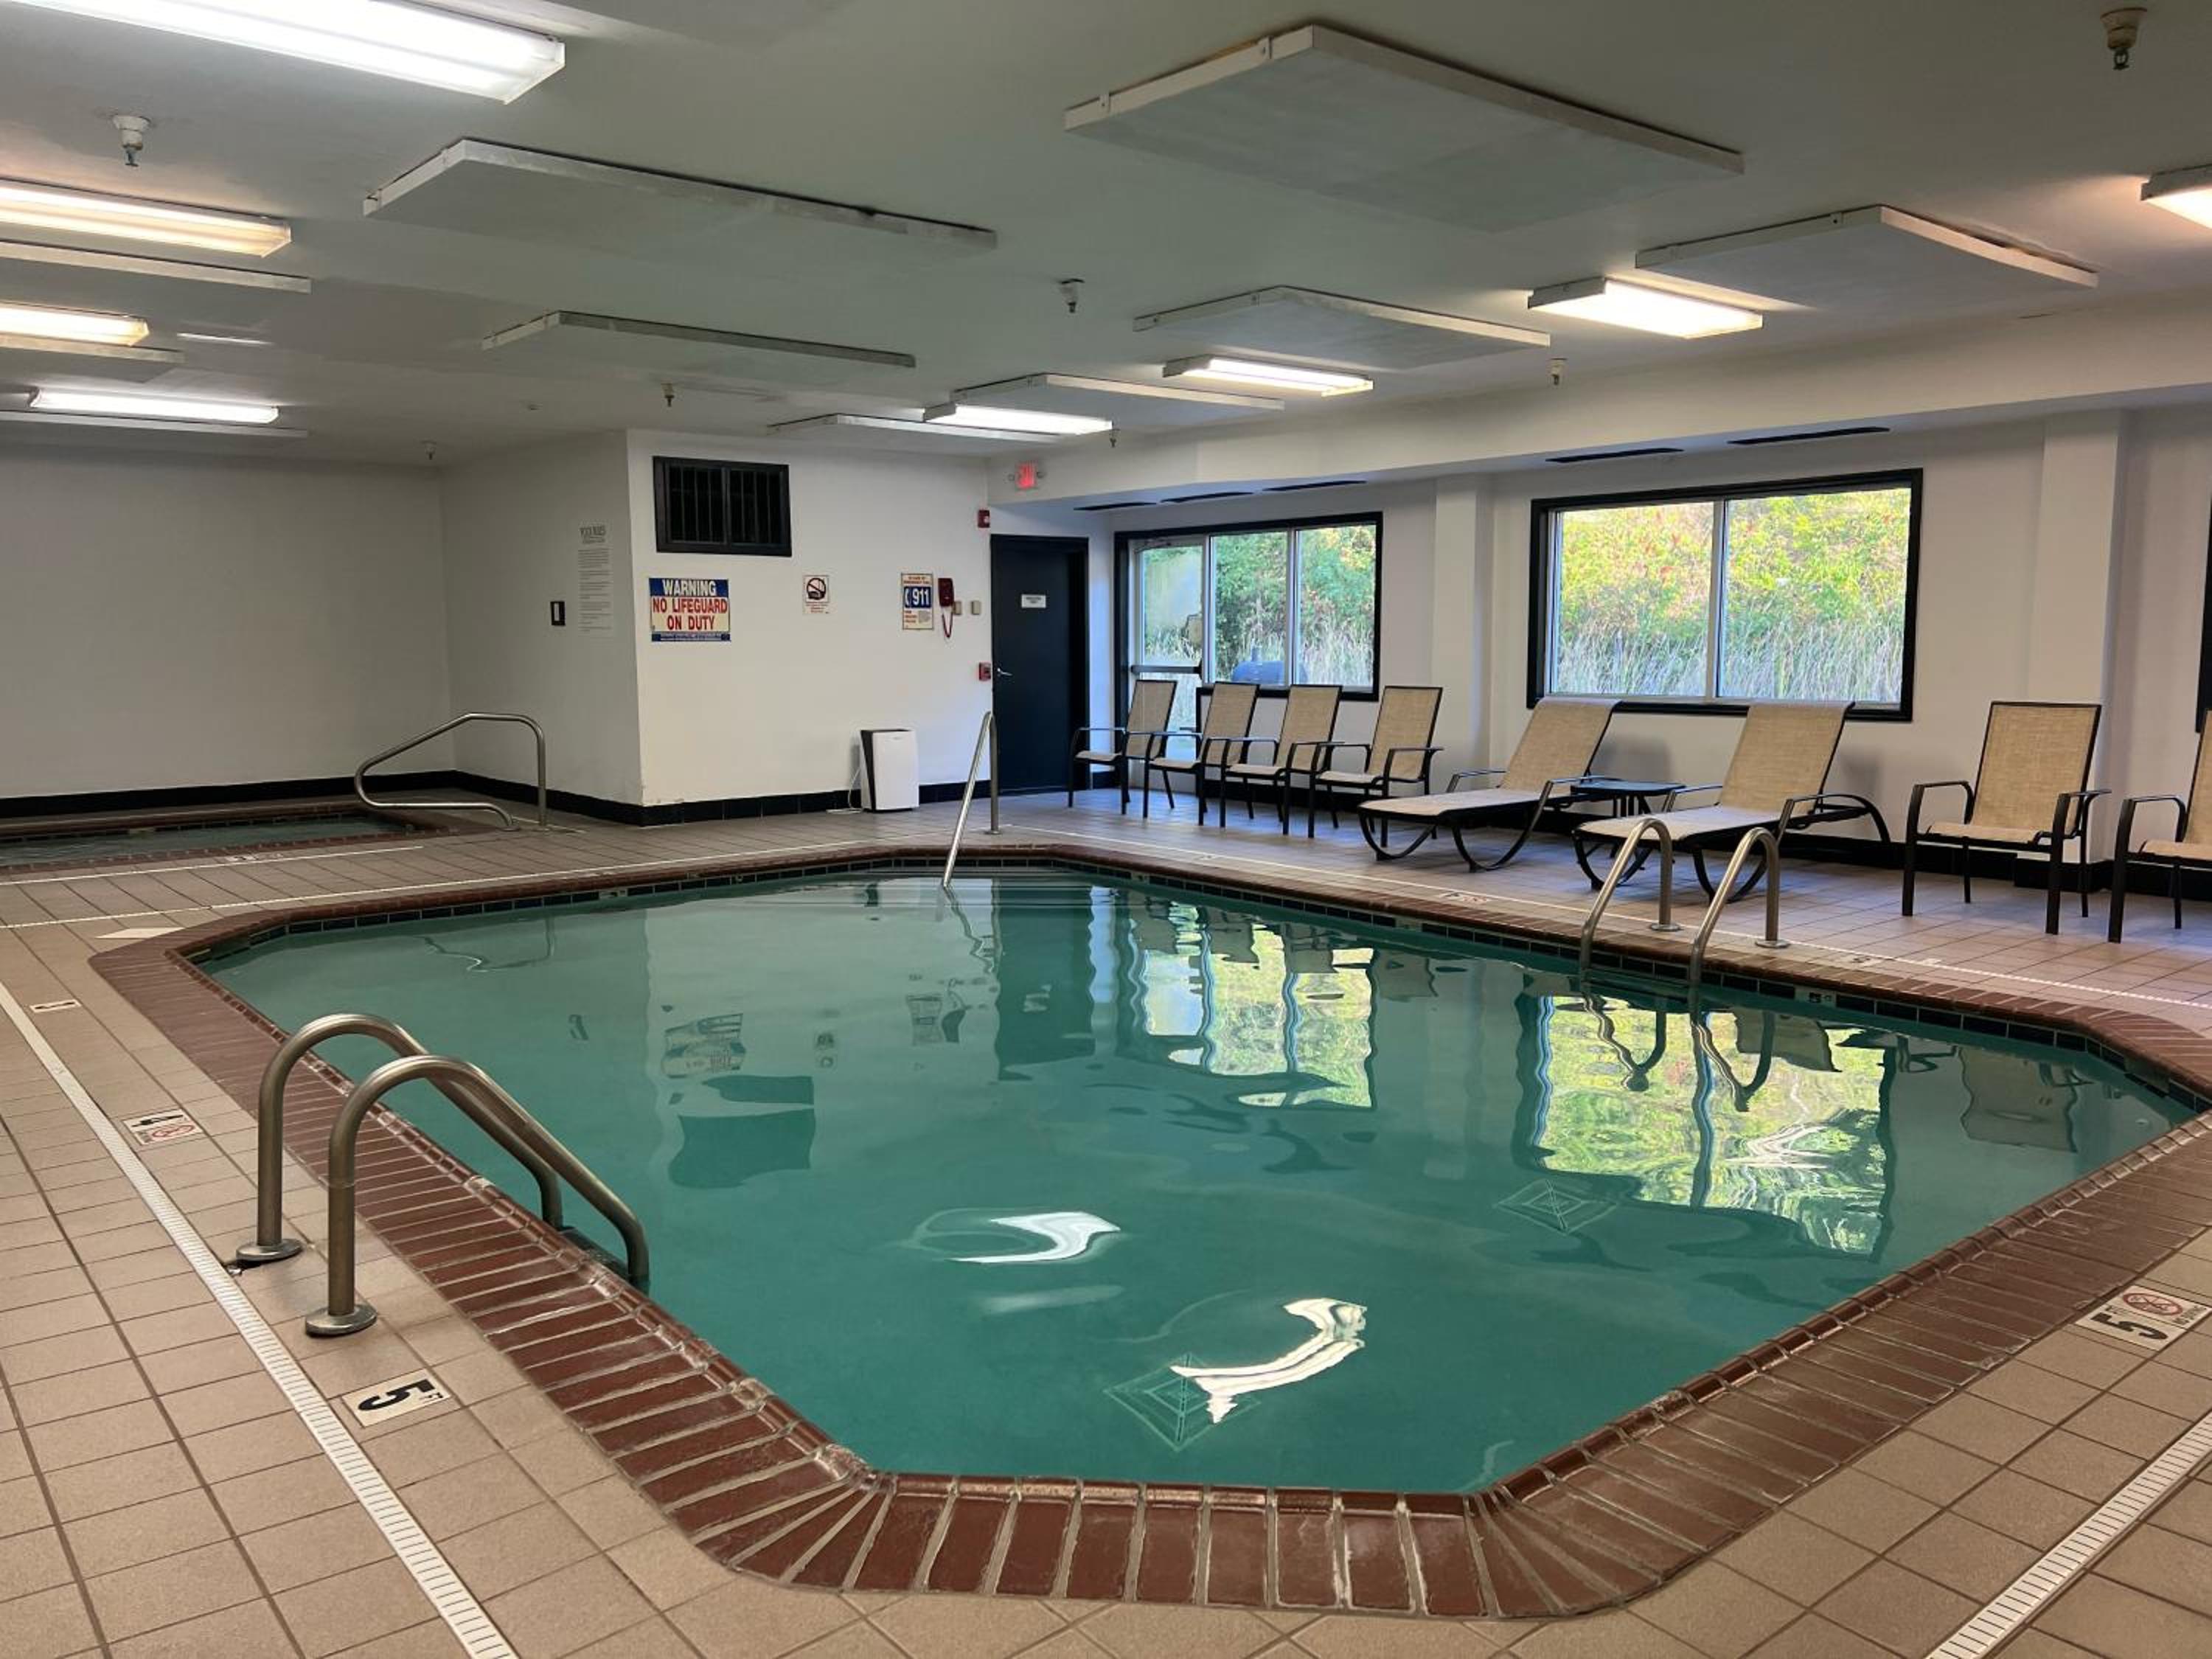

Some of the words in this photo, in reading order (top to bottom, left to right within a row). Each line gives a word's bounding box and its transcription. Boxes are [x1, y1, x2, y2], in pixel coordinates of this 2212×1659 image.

[662, 579, 717, 597] WARNING
[912, 588, 930, 605] 911
[653, 598, 667, 613] NO
[672, 598, 728, 613] LIFEGUARD
[667, 615, 682, 630] ON
[688, 615, 714, 630] DUTY
[2090, 1312, 2168, 1340] 5
[358, 1379, 435, 1411] 5
